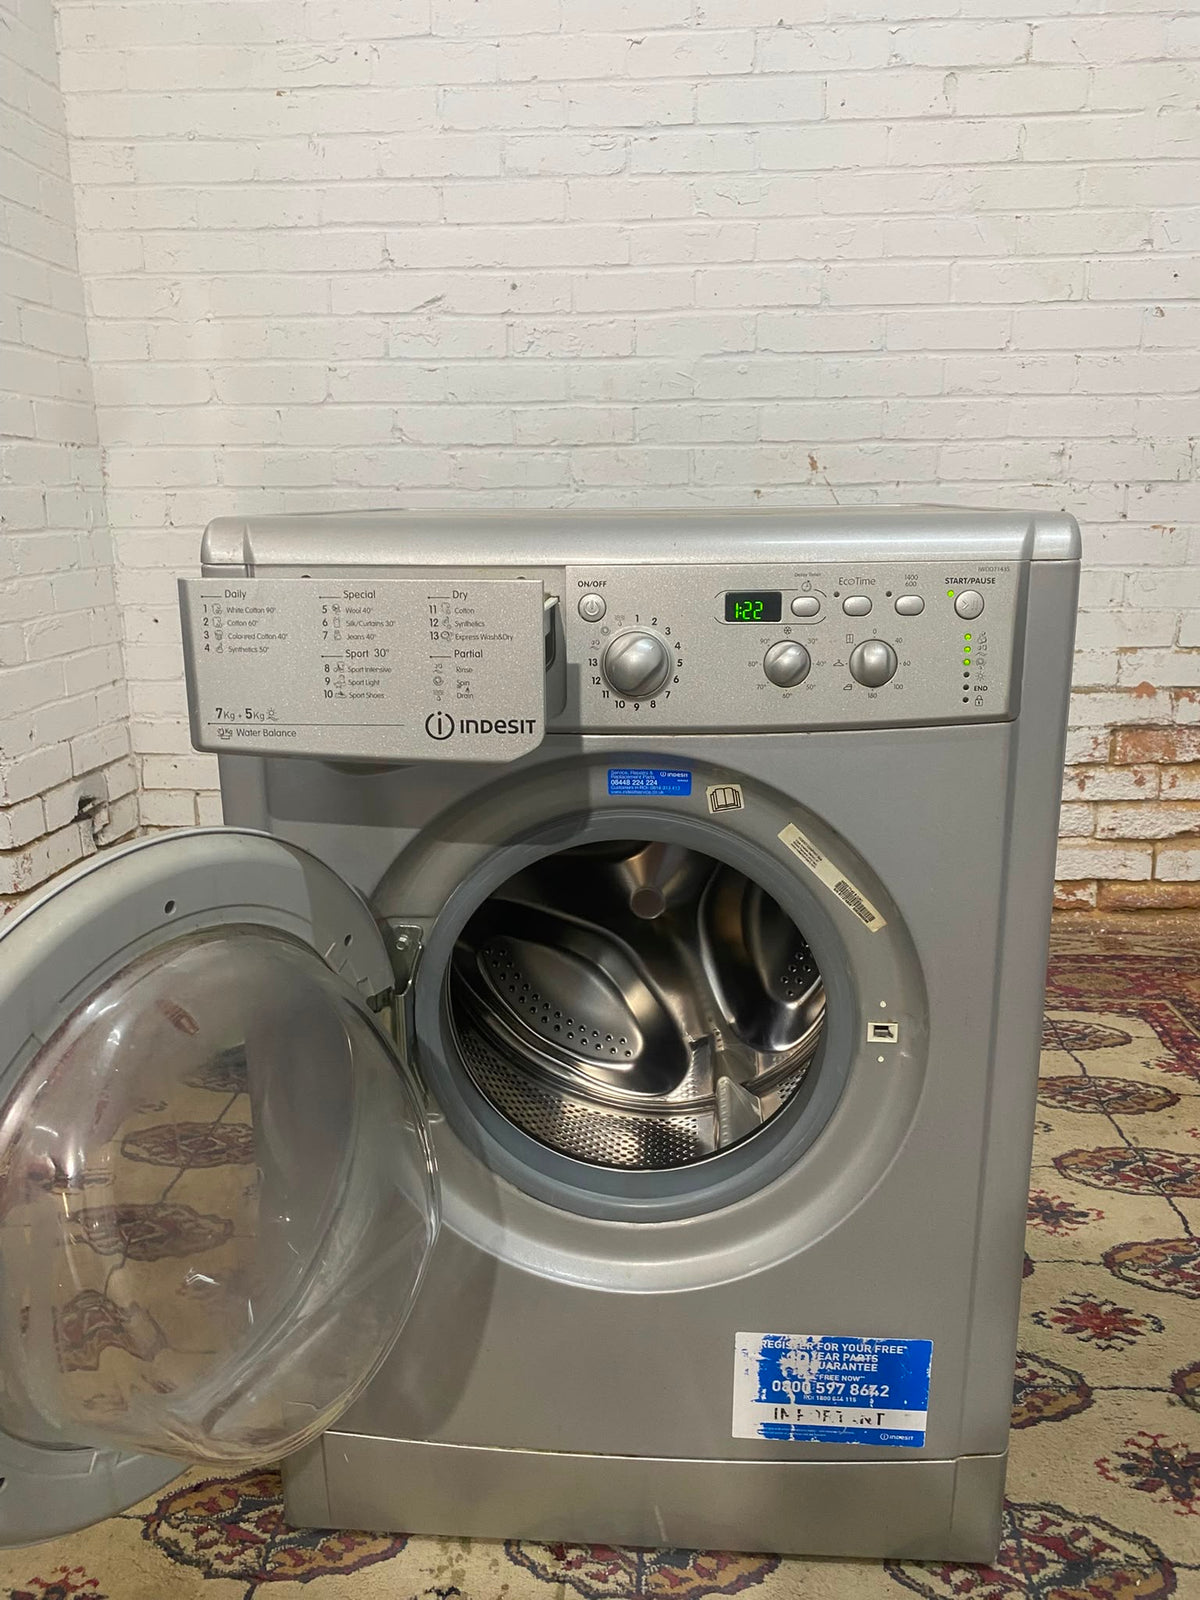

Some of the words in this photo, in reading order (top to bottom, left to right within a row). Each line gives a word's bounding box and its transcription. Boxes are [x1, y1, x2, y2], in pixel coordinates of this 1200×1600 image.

[577, 580, 608, 588] ON/OFF
[838, 576, 876, 586] EcoTime
[944, 577, 996, 585] START/PAUSE
[224, 590, 247, 600] Daily
[343, 590, 376, 601] Special
[452, 590, 468, 600] Dry
[203, 604, 208, 613] 1
[322, 605, 328, 613] 5
[429, 605, 437, 614] 11
[734, 601, 764, 620] 1:22
[203, 617, 209, 626] 2
[322, 619, 328, 627] 6
[635, 614, 639, 623] 1
[652, 618, 658, 626] 2
[429, 619, 439, 627] 12
[454, 620, 485, 628] Synthetics
[204, 630, 209, 639] 3
[665, 627, 671, 635] 3
[323, 632, 328, 640] 7
[430, 632, 440, 640] 13
[480, 633, 514, 641] Wash&Dry
[204, 644, 210, 652] 4
[345, 649, 369, 660] Sport
[374, 648, 390, 658] 30°
[454, 649, 483, 658] Partial
[588, 658, 598, 666] 13
[677, 659, 683, 667] 5
[324, 664, 330, 673] 8
[347, 666, 365, 674] Sport
[325, 677, 330, 685] 9
[592, 676, 601, 685] 12
[673, 675, 680, 683] 6
[324, 690, 333, 698] 10
[615, 700, 625, 708] 10
[634, 703, 640, 711] 9
[650, 700, 656, 708] 8
[236, 728, 261, 737] Water
[263, 728, 297, 737] Balance
[761, 1340, 814, 1350] REGISER
[817, 1342, 839, 1351] FOR
[841, 1344, 872, 1353] YOUR
[842, 1353, 878, 1363] PARTS
[815, 1362, 878, 1372] UARANTEE
[816, 1382, 844, 1395] 597
